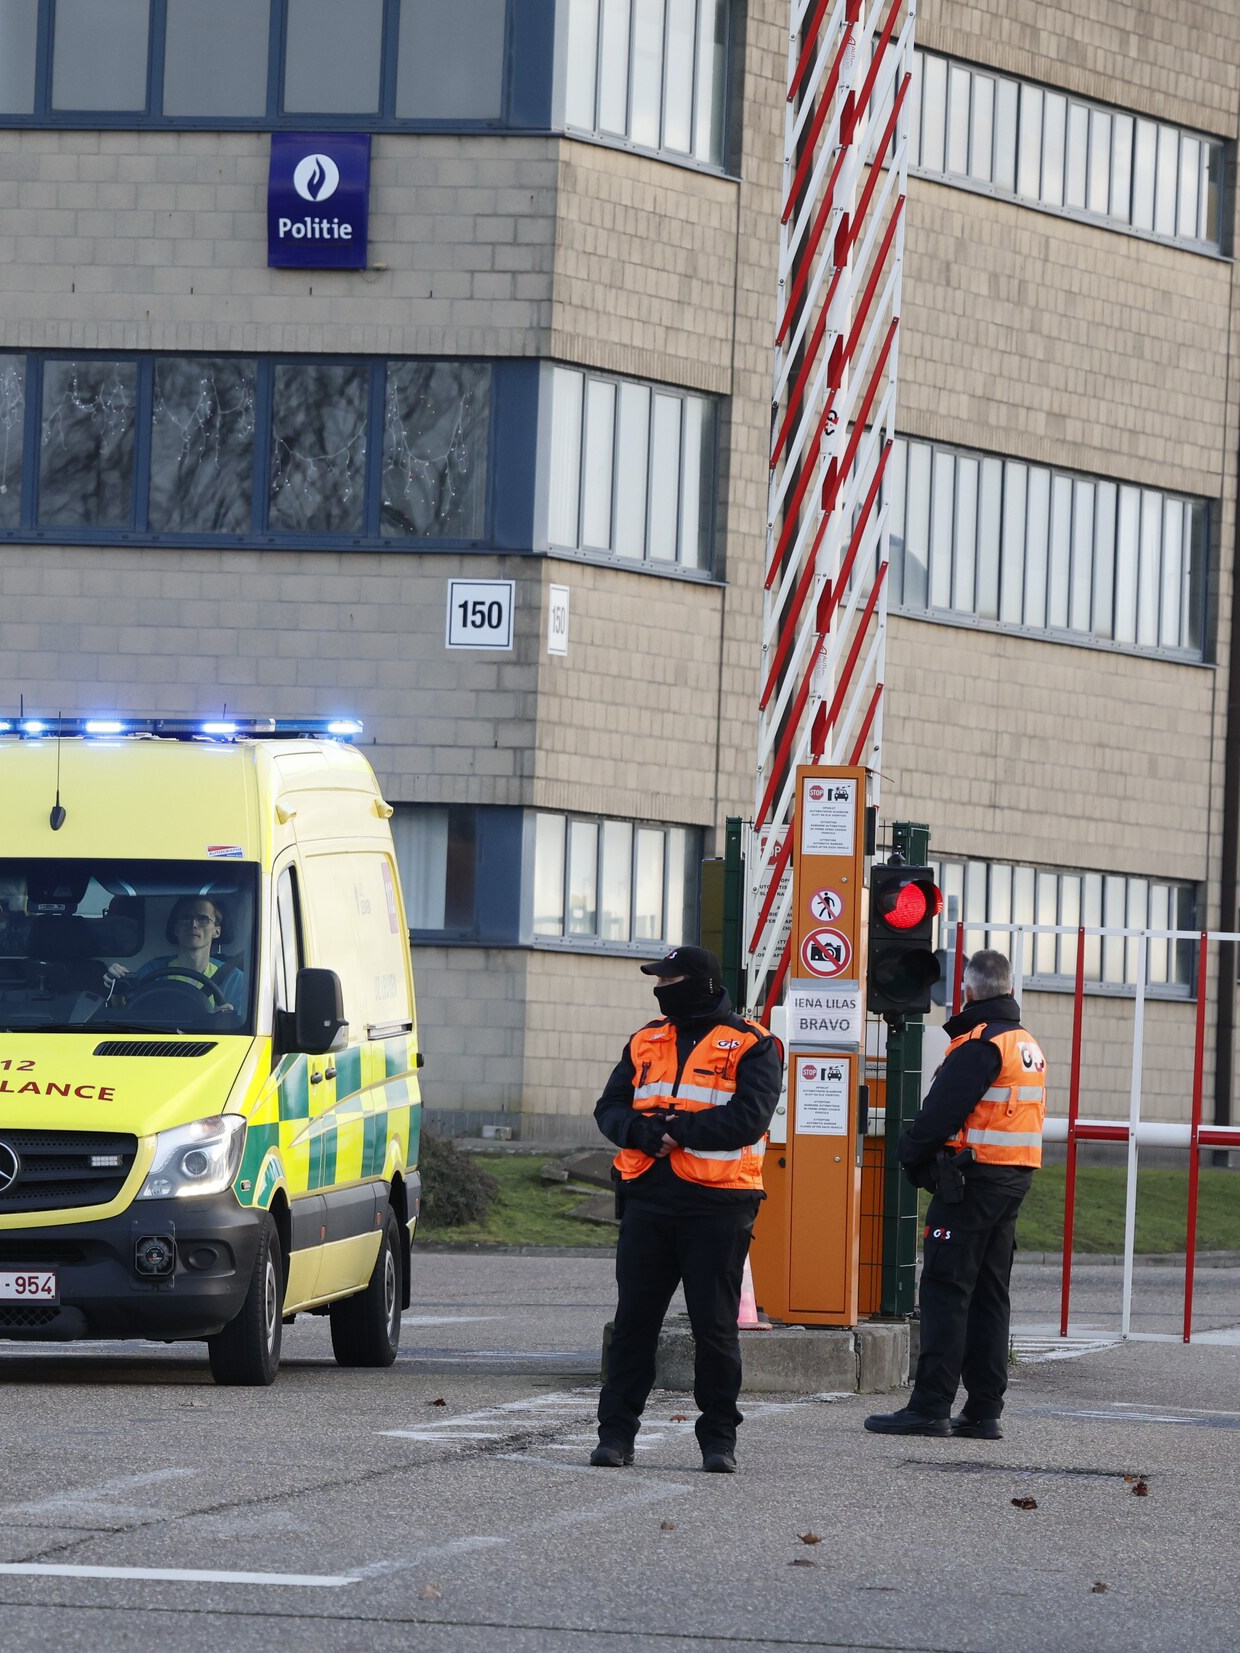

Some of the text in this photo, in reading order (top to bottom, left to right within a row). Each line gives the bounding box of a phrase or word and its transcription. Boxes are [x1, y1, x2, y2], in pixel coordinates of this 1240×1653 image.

[278, 216, 353, 239] Politie
[458, 600, 503, 629] 150
[552, 606, 566, 634] 150
[809, 789, 824, 797] STOP
[794, 998, 857, 1010] IENA LILAS
[799, 1018, 851, 1031] BRAVO
[802, 1068, 817, 1076] STOP
[933, 1228, 951, 1240] G4S
